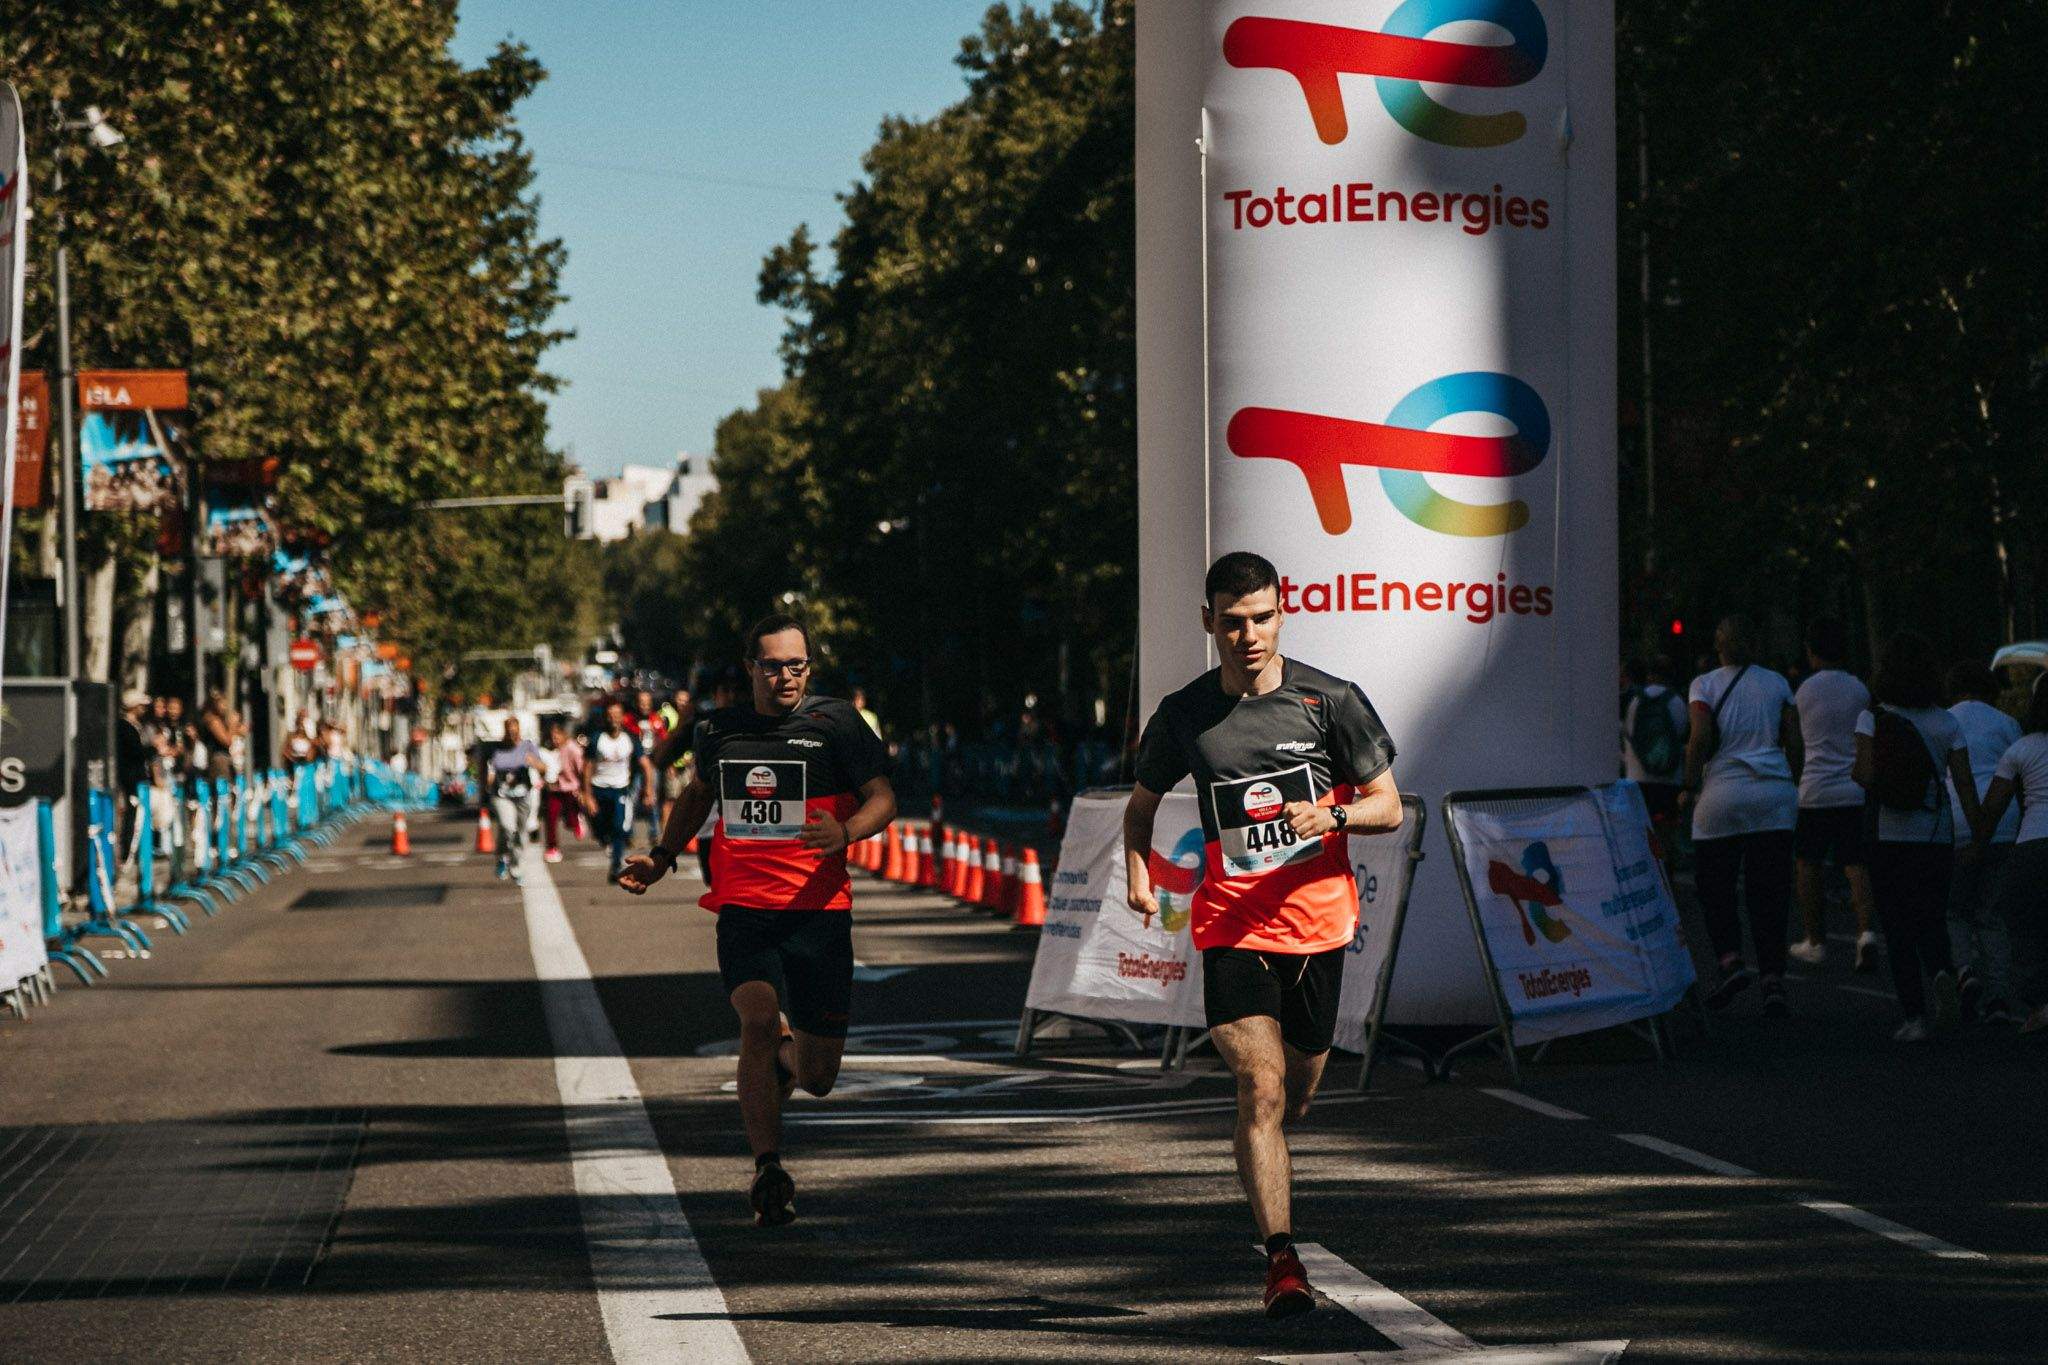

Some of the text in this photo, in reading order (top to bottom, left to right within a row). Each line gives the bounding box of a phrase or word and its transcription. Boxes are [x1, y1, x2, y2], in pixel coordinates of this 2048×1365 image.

[1223, 183, 1549, 236] TotalEnergies
[1281, 573, 1553, 625] talEnergies
[741, 801, 782, 825] 430
[1246, 820, 1298, 853] 448
